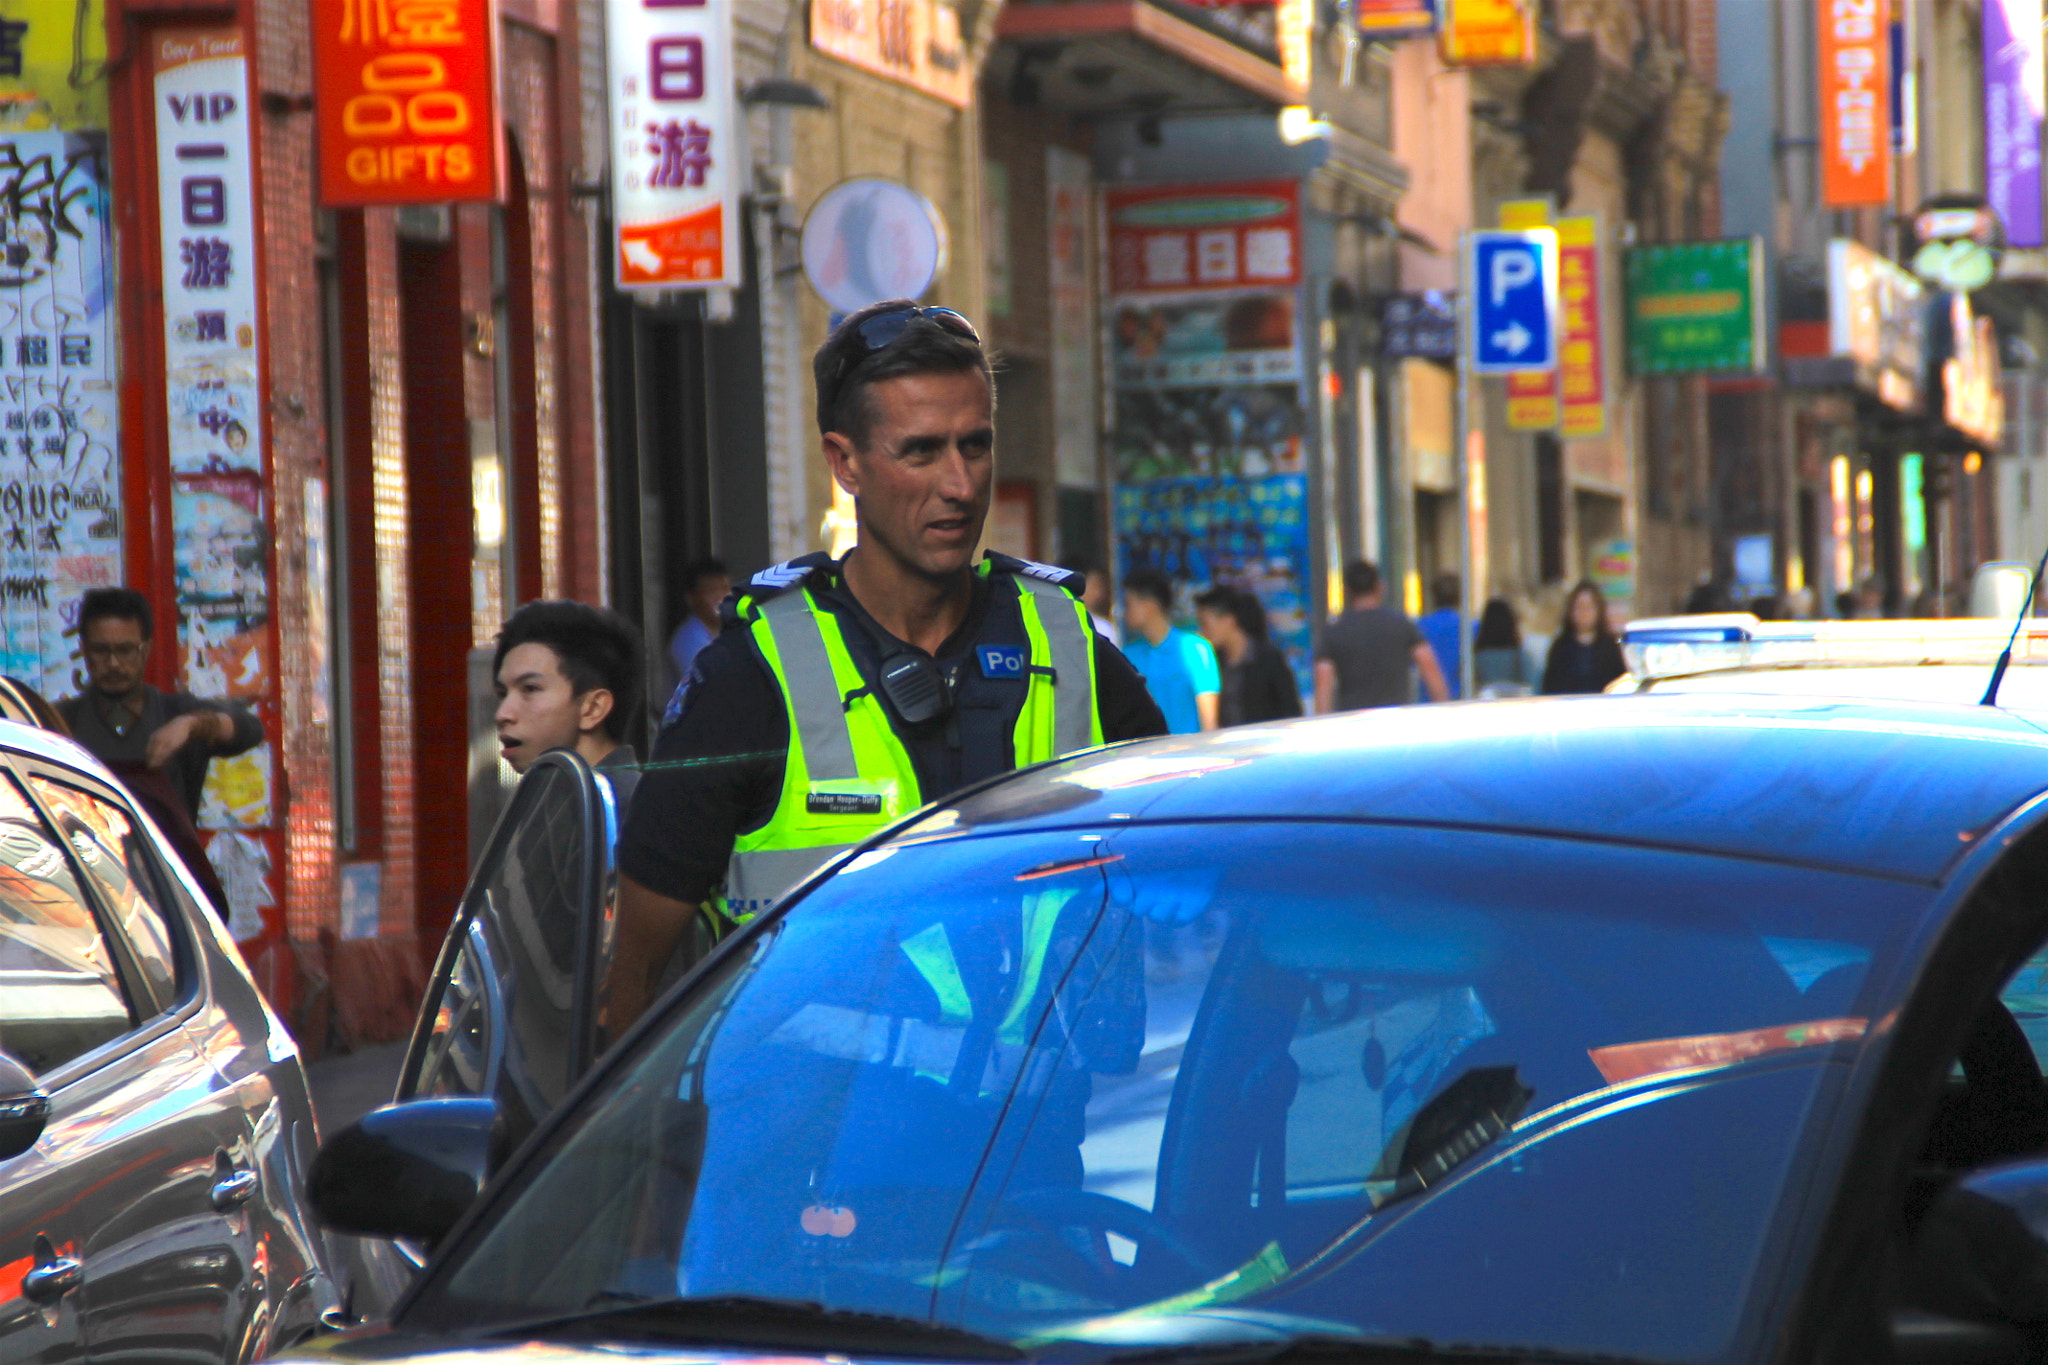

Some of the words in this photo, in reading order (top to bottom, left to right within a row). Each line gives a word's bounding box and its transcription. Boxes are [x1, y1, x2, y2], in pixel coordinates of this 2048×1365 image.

[166, 92, 237, 123] VIP
[346, 144, 470, 182] GIFTS
[175, 141, 234, 289] 一日游
[1491, 250, 1536, 308] P
